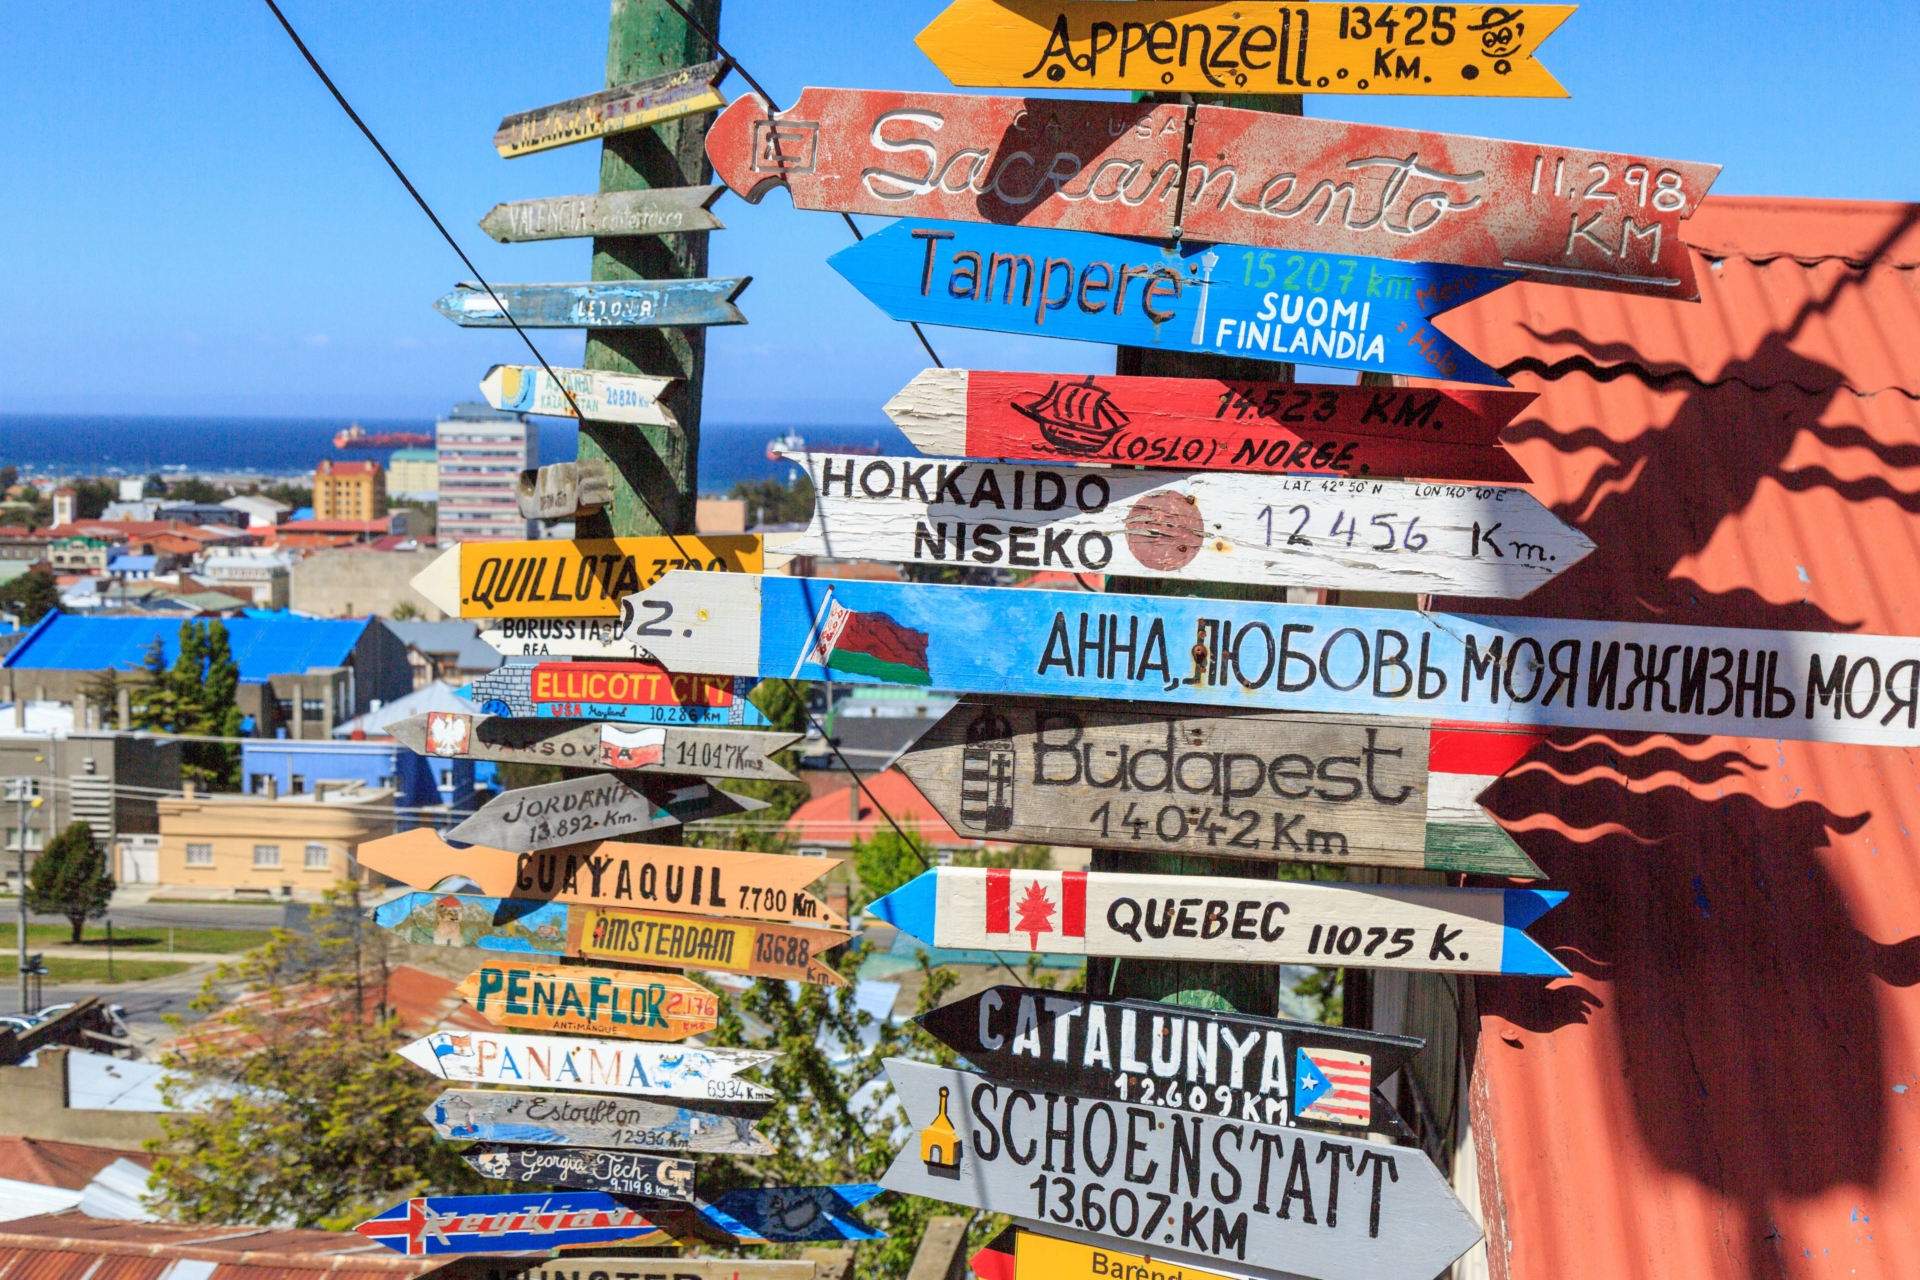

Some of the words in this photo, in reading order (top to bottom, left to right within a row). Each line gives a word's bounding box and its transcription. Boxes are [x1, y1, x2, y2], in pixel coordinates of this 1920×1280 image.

[1339, 6, 1457, 46] 13425
[1108, 115, 1184, 141] USA
[861, 108, 1486, 237] Sacramento
[1566, 211, 1664, 266] KM
[911, 227, 1182, 327] Tampere
[1366, 263, 1413, 301] km
[1415, 273, 1478, 311] Moro
[1256, 291, 1370, 331] SUOMI
[1215, 318, 1385, 364] FINLANDIA
[1407, 327, 1457, 379] Hola
[605, 386, 638, 408] 20820
[1112, 431, 1218, 463] (OSLO)
[823, 457, 1112, 513] HOKKAIDO
[1372, 484, 1384, 495] N
[914, 519, 1114, 571] NISEKO
[1256, 503, 1430, 553] 12456
[471, 554, 639, 611] QUILLOTA
[503, 618, 600, 641] BORUSSIA
[536, 671, 662, 701] ELLICOTT
[670, 674, 731, 704] CITY
[551, 702, 583, 717] USA
[1804, 652, 1920, 730] МОЯ
[1032, 710, 1415, 818] Budapest
[1089, 799, 1262, 852] 14042
[1270, 811, 1351, 857] Km
[516, 852, 727, 908] GUAYAQUIL
[592, 915, 735, 964] AMSTERDAM
[1106, 896, 1291, 943] QUEBEC
[1307, 924, 1416, 960] 11075
[476, 1039, 653, 1088] PANAMA
[978, 988, 1290, 1098] CATALUNYA
[520, 1148, 586, 1182] Georgia
[592, 1152, 649, 1182] Tech
[970, 1083, 1399, 1238] SCHOENSTATT
[410, 1197, 668, 1246] Reykjavi
